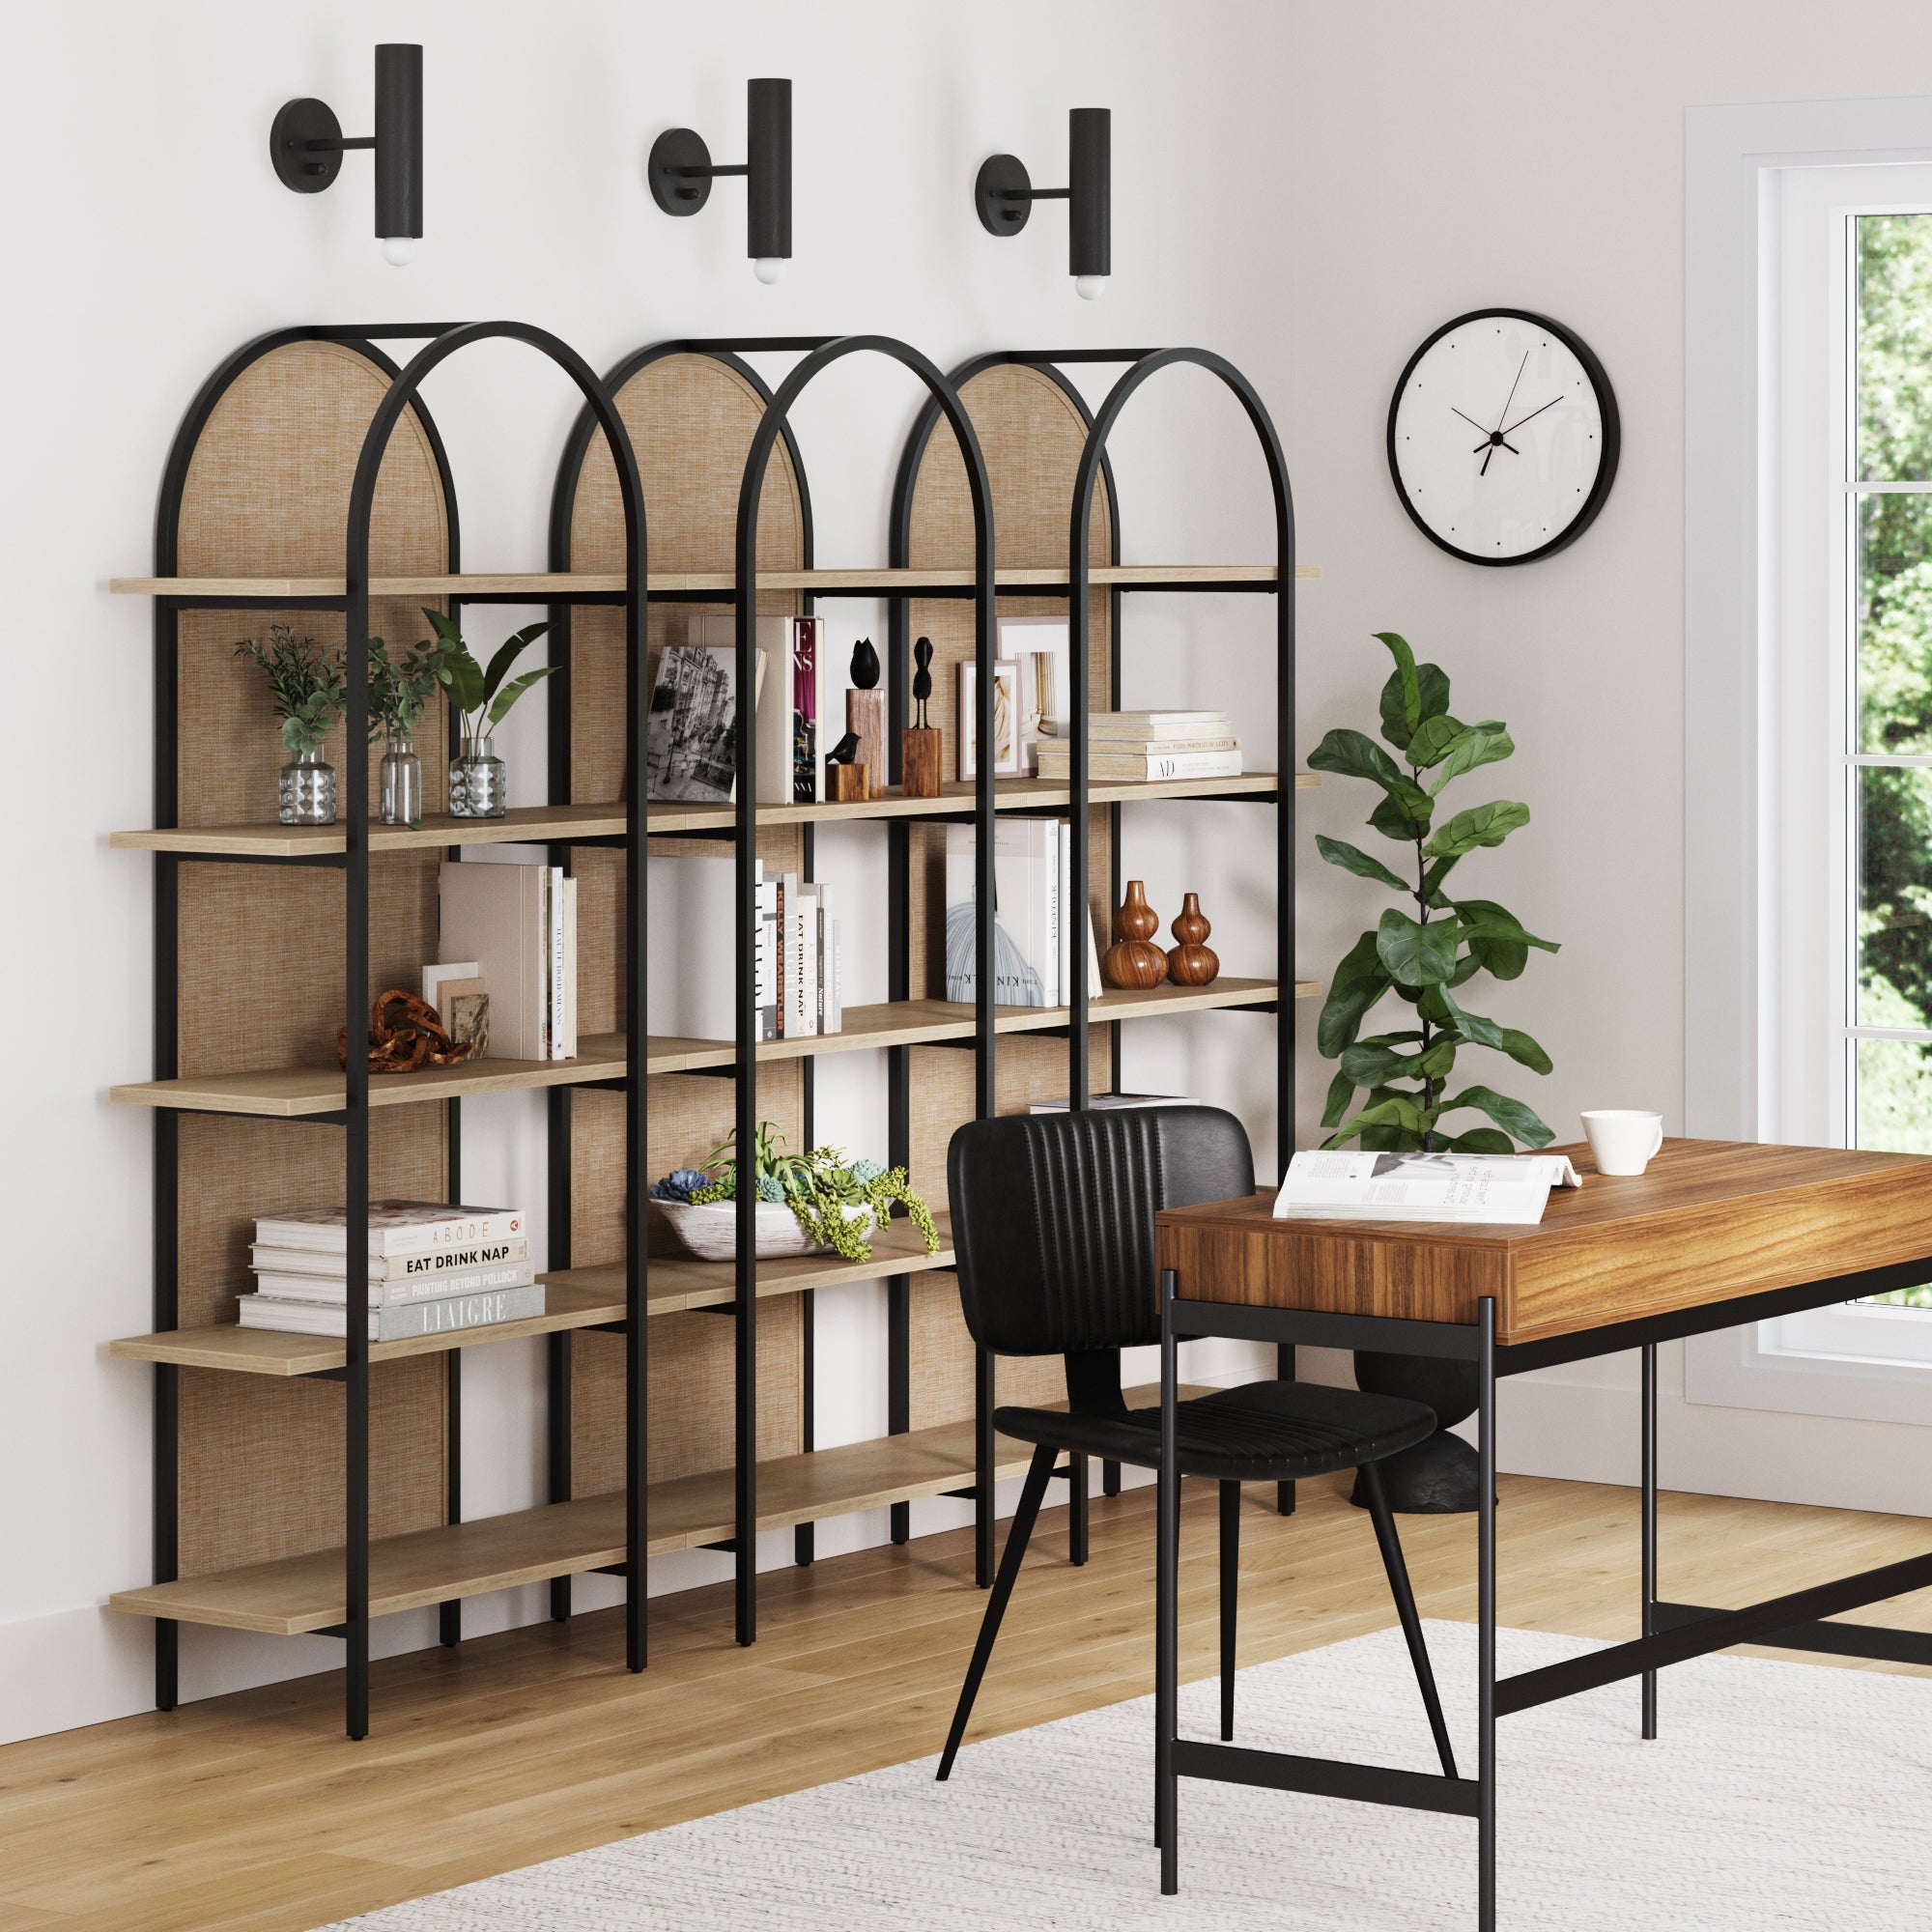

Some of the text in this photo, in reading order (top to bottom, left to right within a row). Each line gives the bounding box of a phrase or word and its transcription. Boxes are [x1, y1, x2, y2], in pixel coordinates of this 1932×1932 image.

[433, 1221, 489, 1243] ABODE
[407, 1257, 432, 1273] EAT
[436, 1250, 478, 1269] DRINK
[481, 1246, 509, 1263] NAP
[412, 1279, 448, 1297] PAINTING
[449, 1274, 481, 1292] BEYOND
[483, 1268, 518, 1286] POLLOCK
[423, 1293, 506, 1332] LIAIGRE
